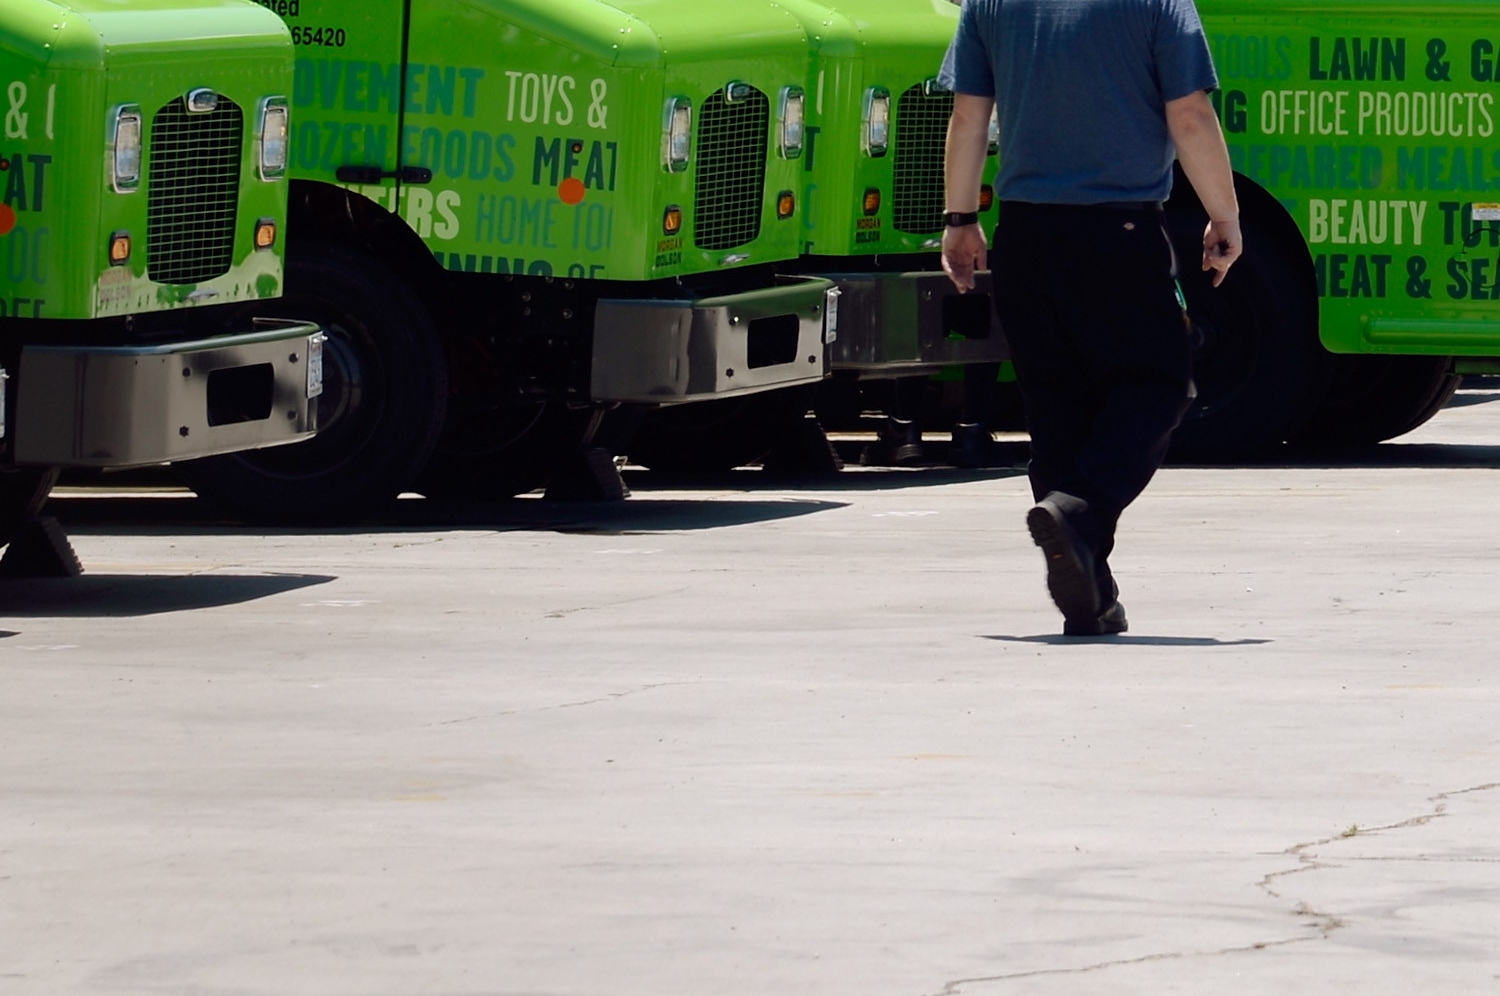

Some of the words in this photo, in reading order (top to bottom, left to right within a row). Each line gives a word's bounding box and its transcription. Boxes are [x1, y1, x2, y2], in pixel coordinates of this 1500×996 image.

[289, 26, 345, 47] 65420
[1309, 37, 1406, 81] LAWN
[1425, 38, 1451, 82] &
[5, 81, 28, 139] &
[294, 59, 485, 118] OVEMENT
[505, 71, 576, 127] TOYS
[587, 78, 608, 130] &
[1261, 90, 1349, 135] OFFICE
[1358, 91, 1494, 137] PRODUCTS
[403, 124, 516, 183] FOODS
[477, 193, 558, 248] HOME
[1309, 199, 1428, 245] BEAUTY
[1406, 256, 1431, 299] &
